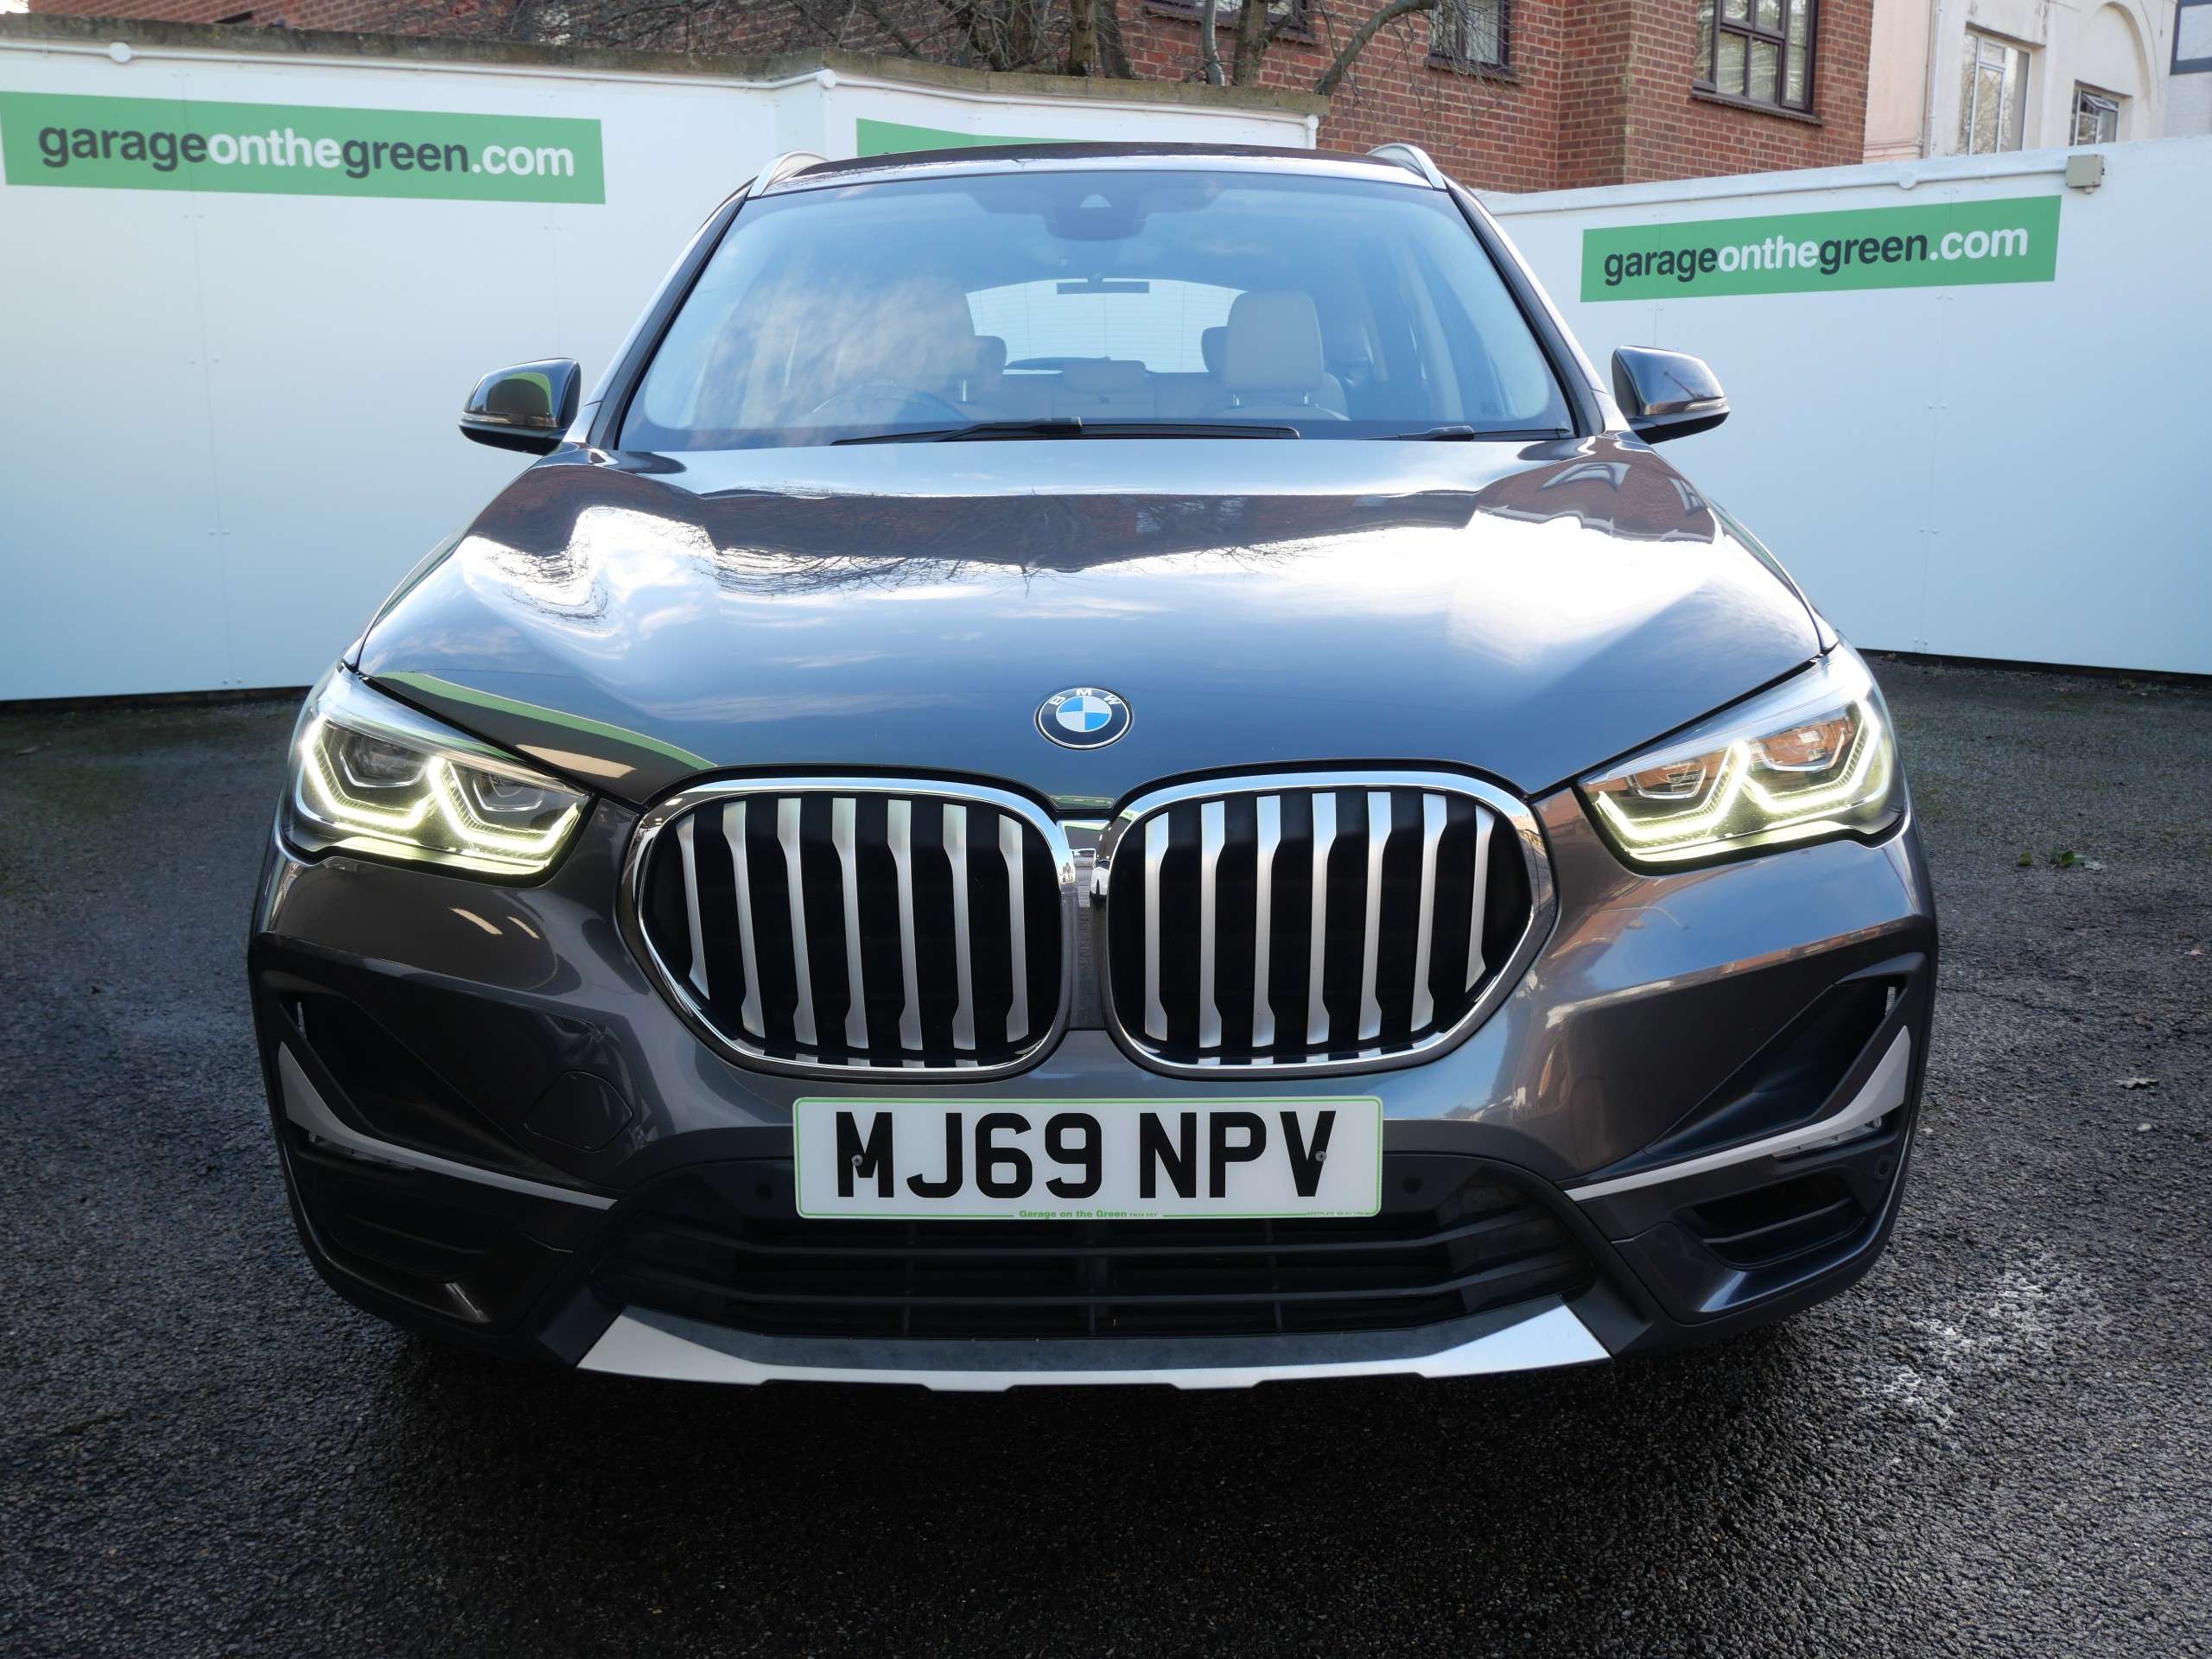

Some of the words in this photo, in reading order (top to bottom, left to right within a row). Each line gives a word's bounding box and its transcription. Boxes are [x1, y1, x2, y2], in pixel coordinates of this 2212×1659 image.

[38, 125, 575, 179] garageonthegreen.com
[1604, 227, 2029, 287] garageonthegreen.com
[1049, 689, 1122, 706] BMW
[835, 1111, 1103, 1199] MJ69
[1138, 1110, 1337, 1199] NPV
[1019, 1210, 1057, 1218] Garage
